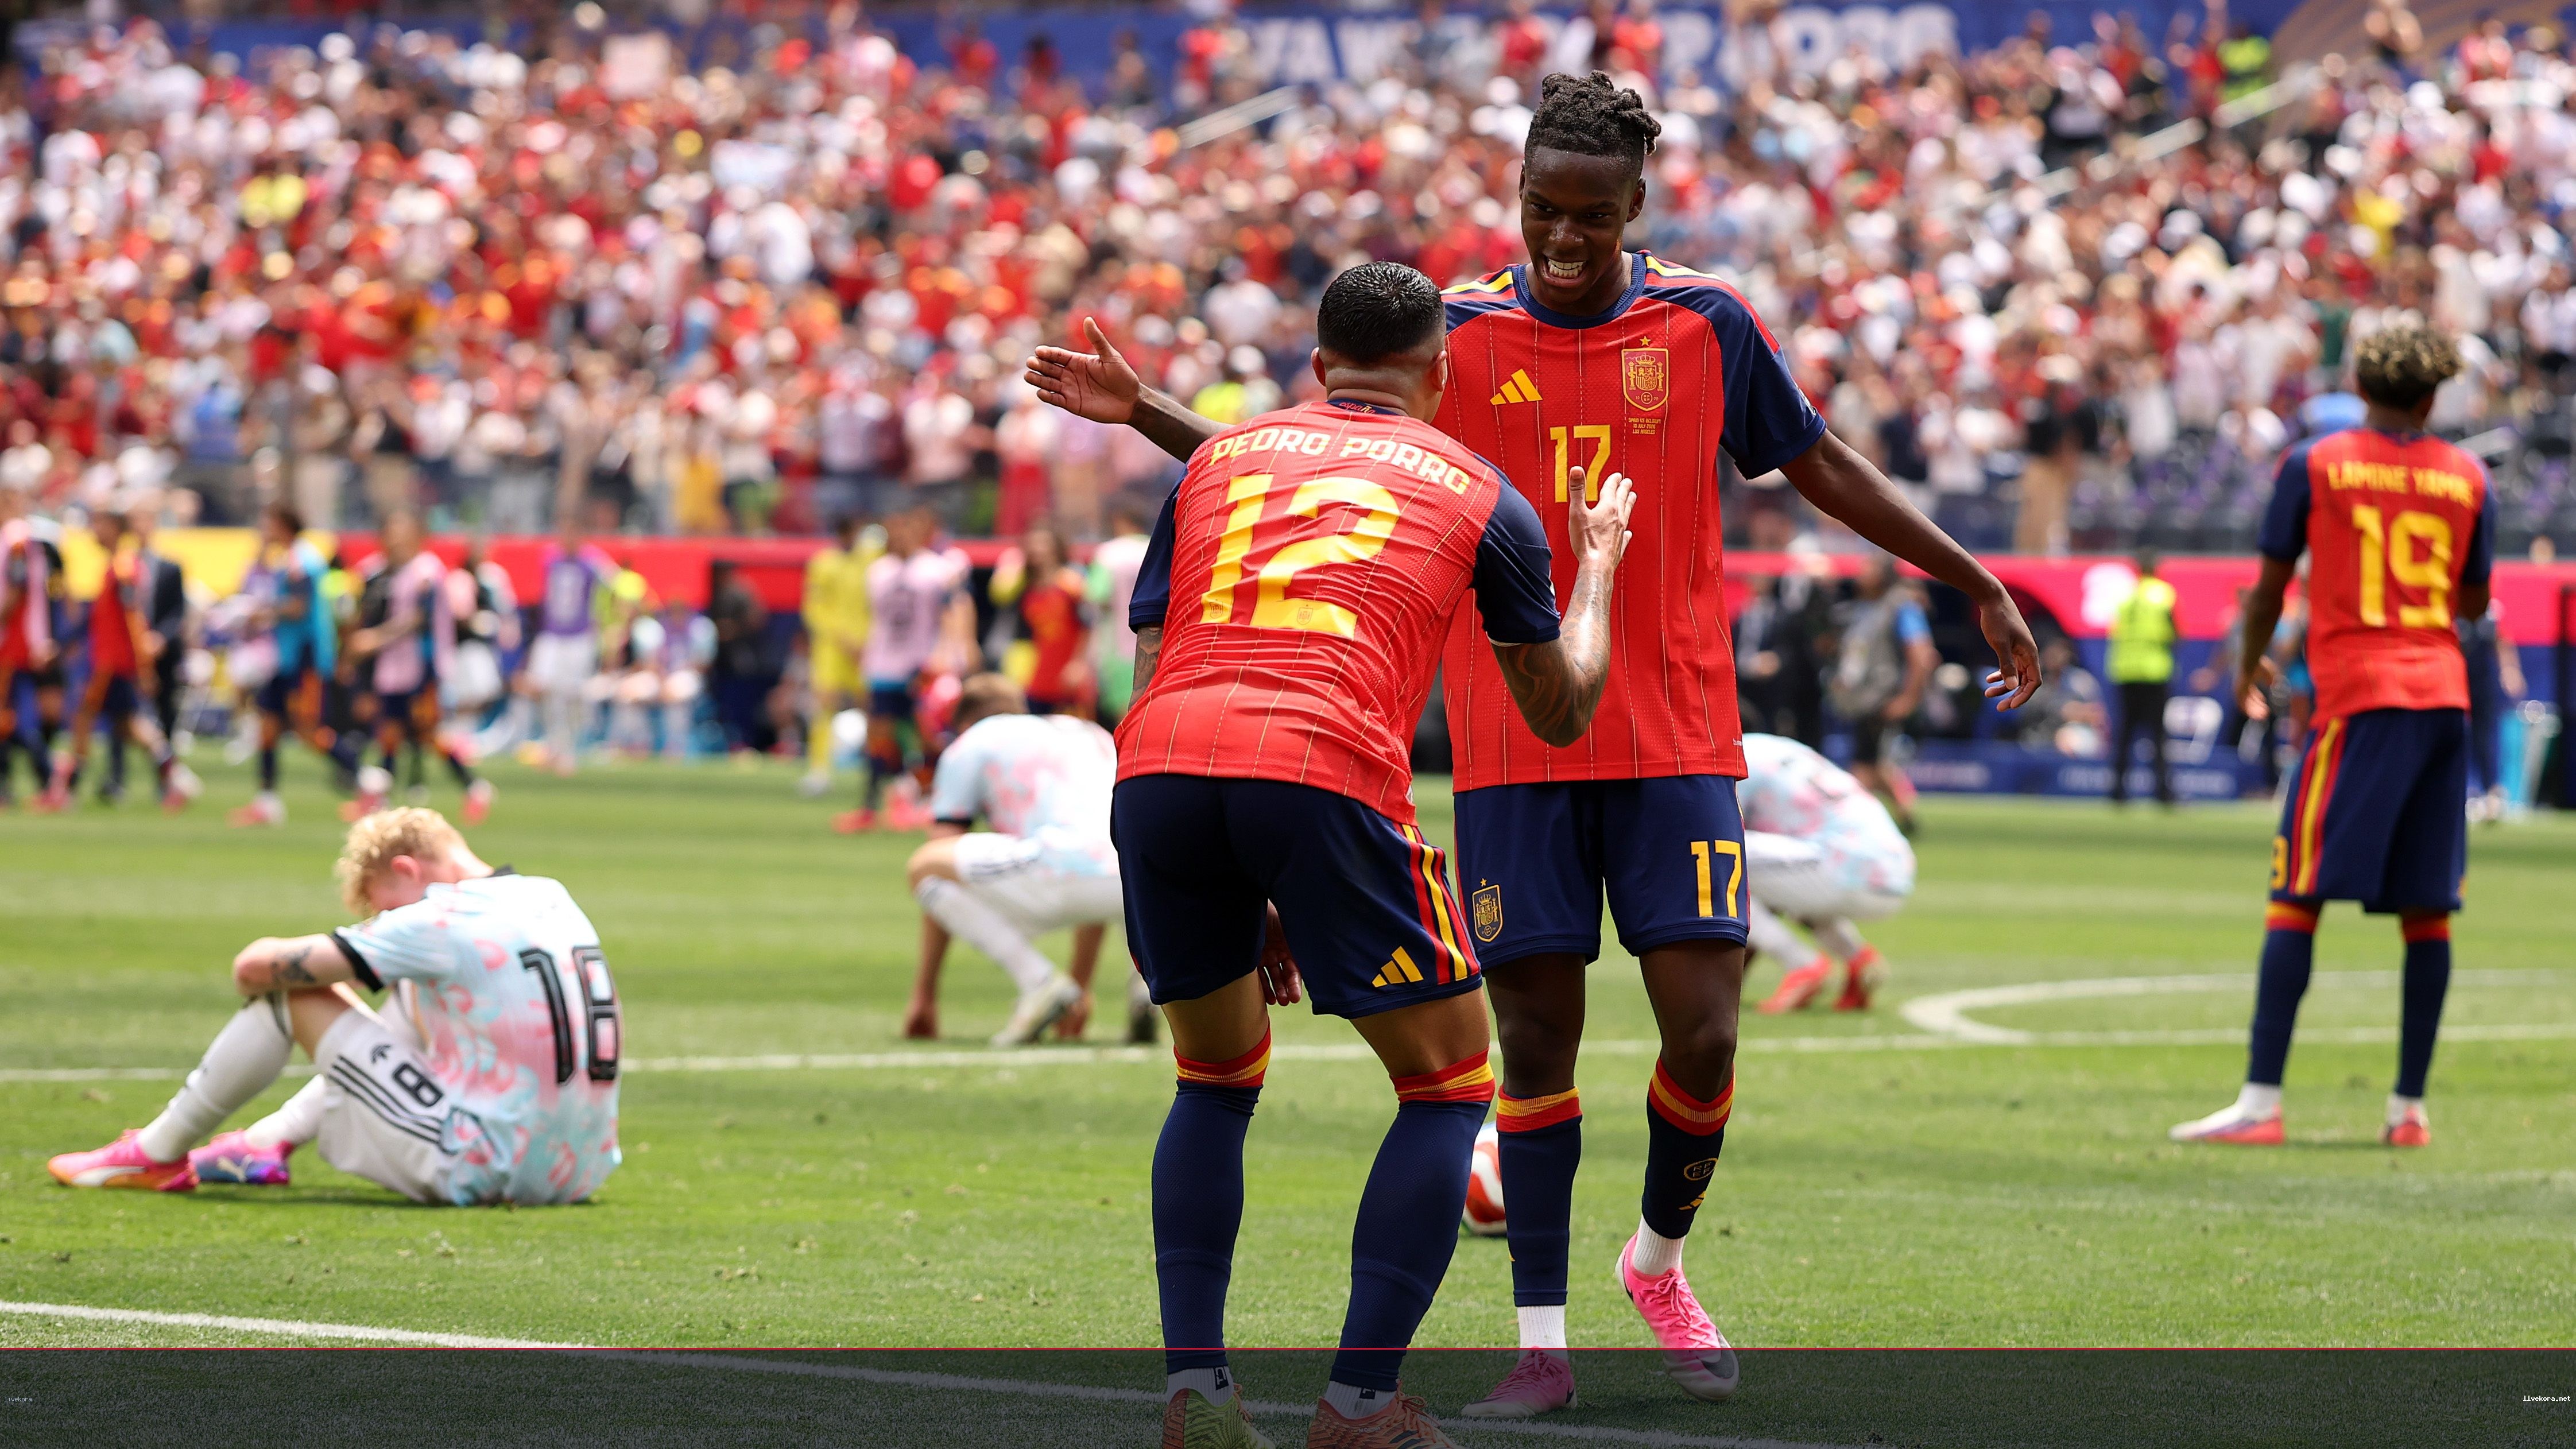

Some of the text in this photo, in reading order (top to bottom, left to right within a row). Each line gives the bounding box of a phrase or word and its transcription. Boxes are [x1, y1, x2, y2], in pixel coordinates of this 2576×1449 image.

[1208, 428, 1471, 495] PEDRO PORRO
[1550, 424, 1611, 503] 17
[1200, 474, 1400, 639] 12
[2352, 503, 2453, 629] 19
[1690, 839, 1742, 919] 17
[518, 946, 618, 1084] 18
